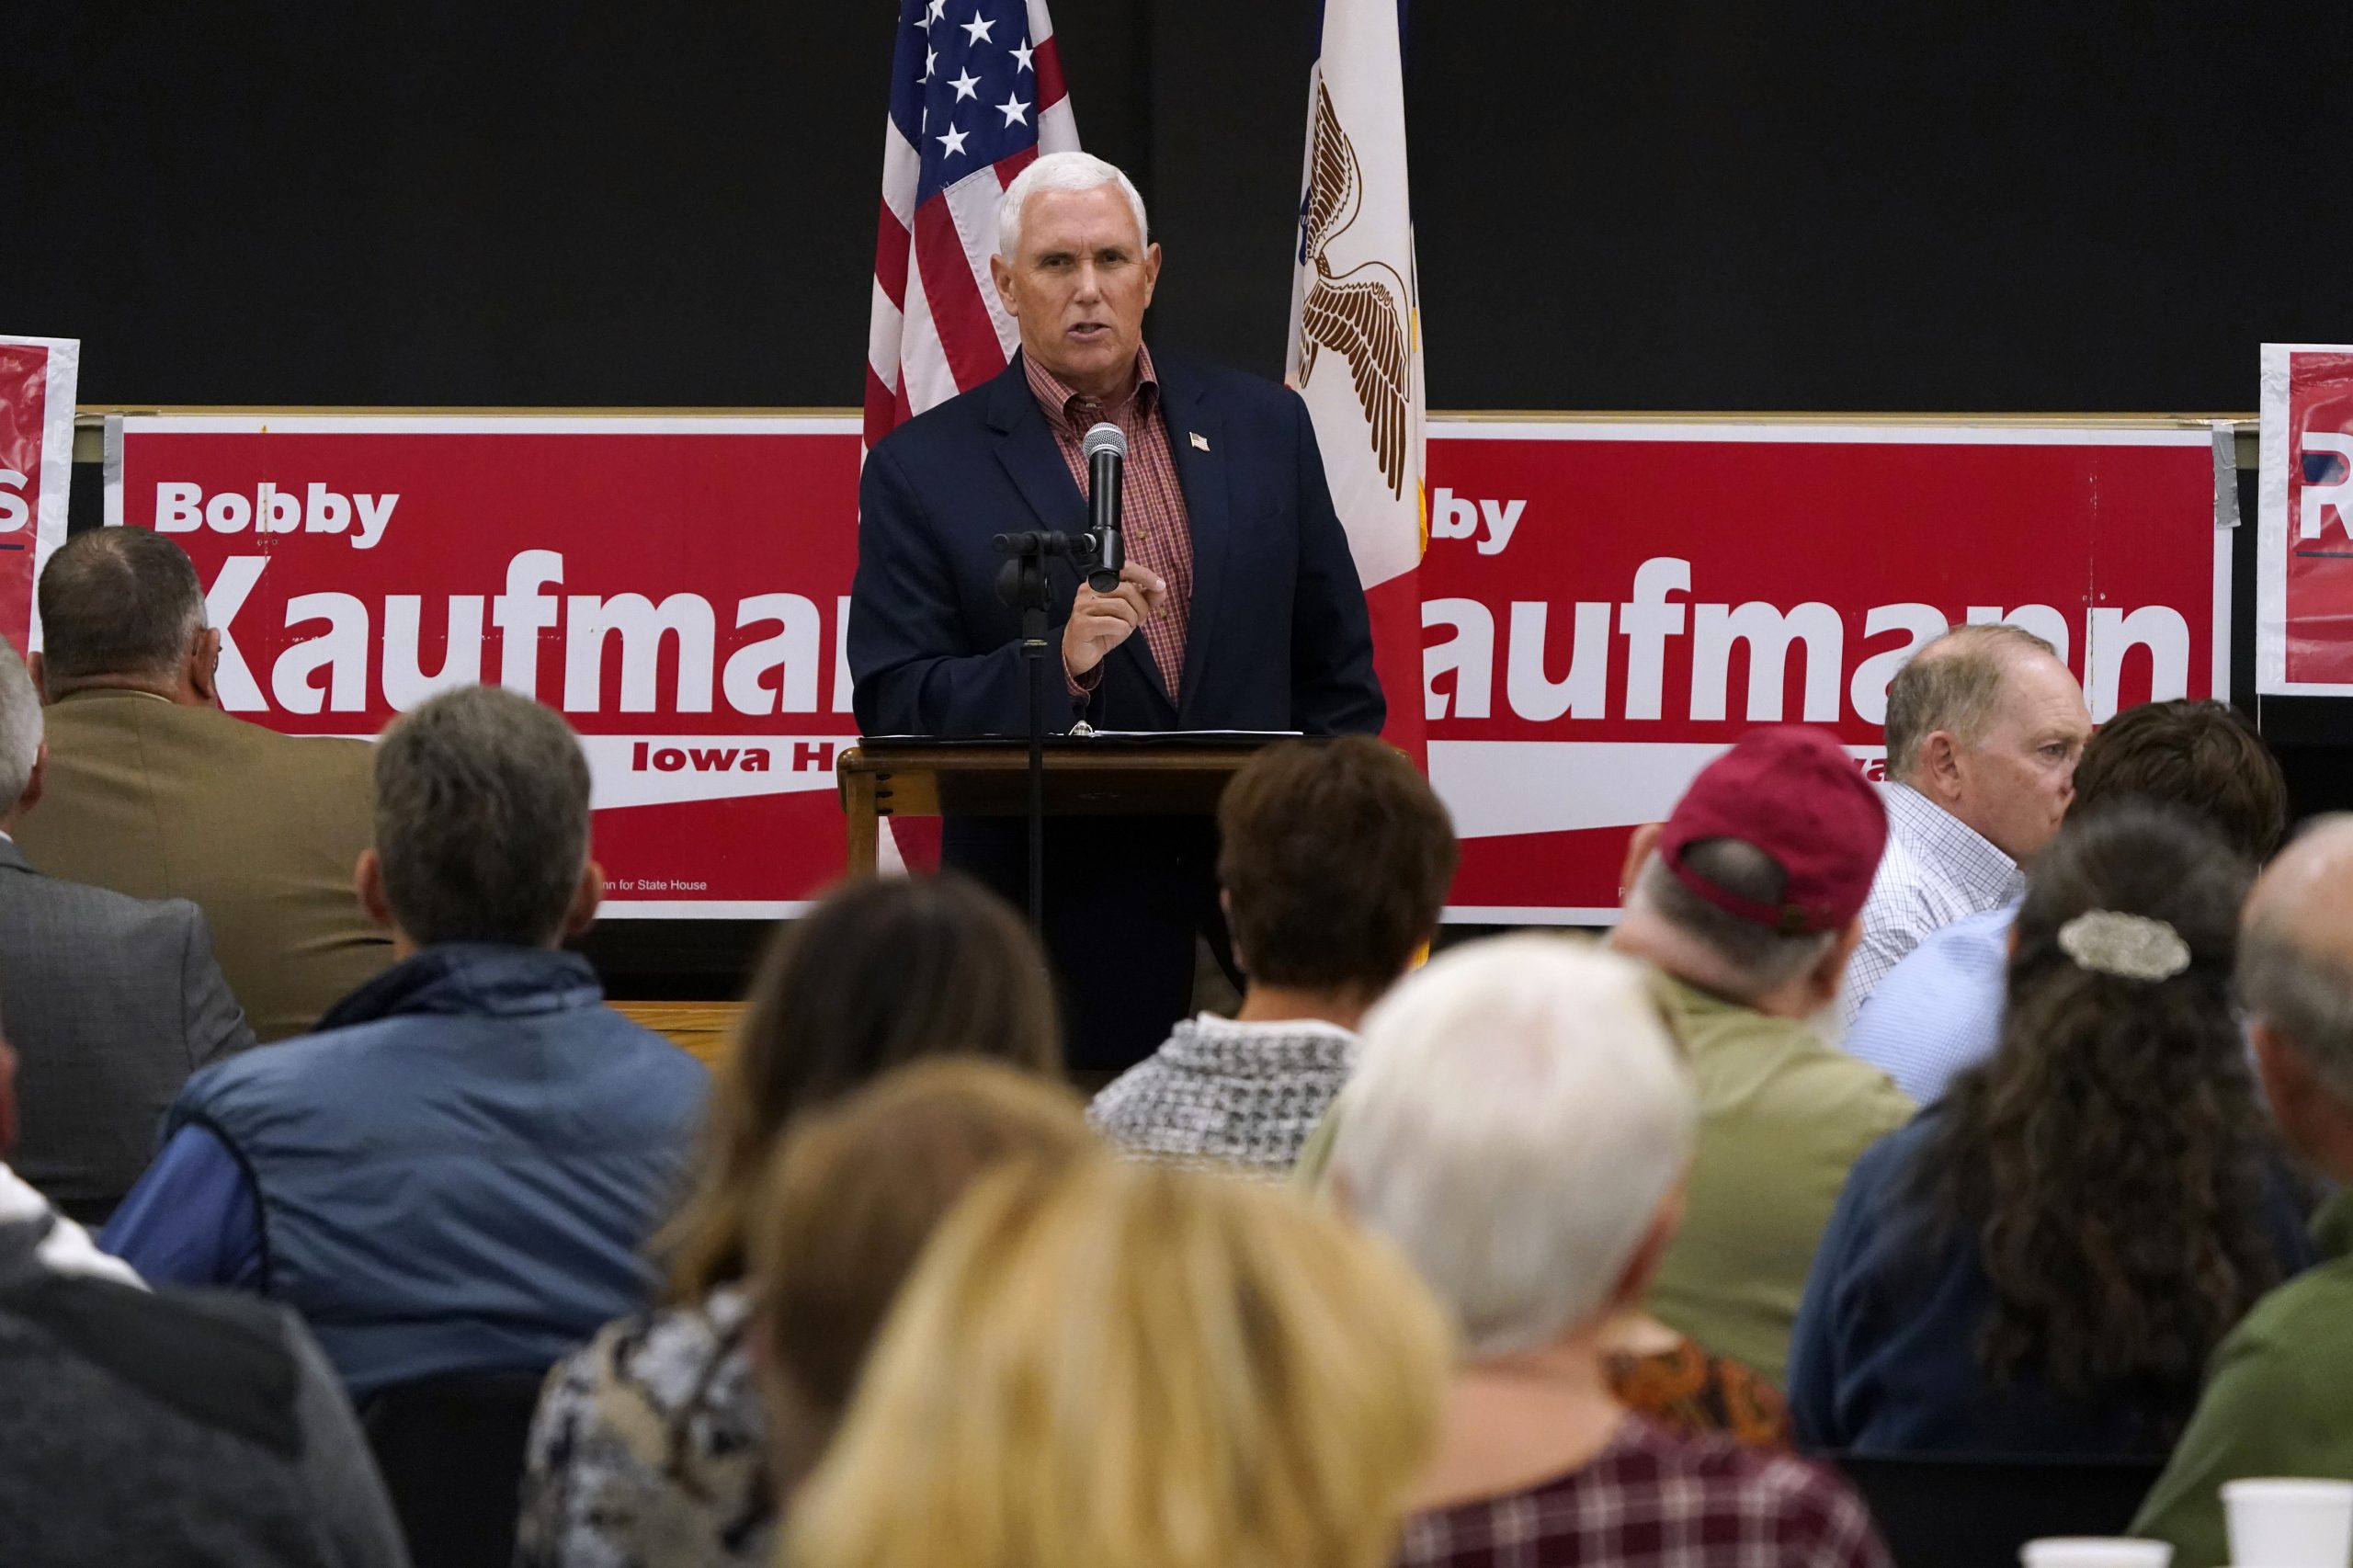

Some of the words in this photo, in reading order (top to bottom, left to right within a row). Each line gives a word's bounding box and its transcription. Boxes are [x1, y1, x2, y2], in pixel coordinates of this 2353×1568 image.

[154, 483, 399, 549] Bobby
[632, 742, 770, 772] Iowa
[620, 879, 634, 891] for
[637, 879, 667, 891] State
[670, 879, 707, 891] House
